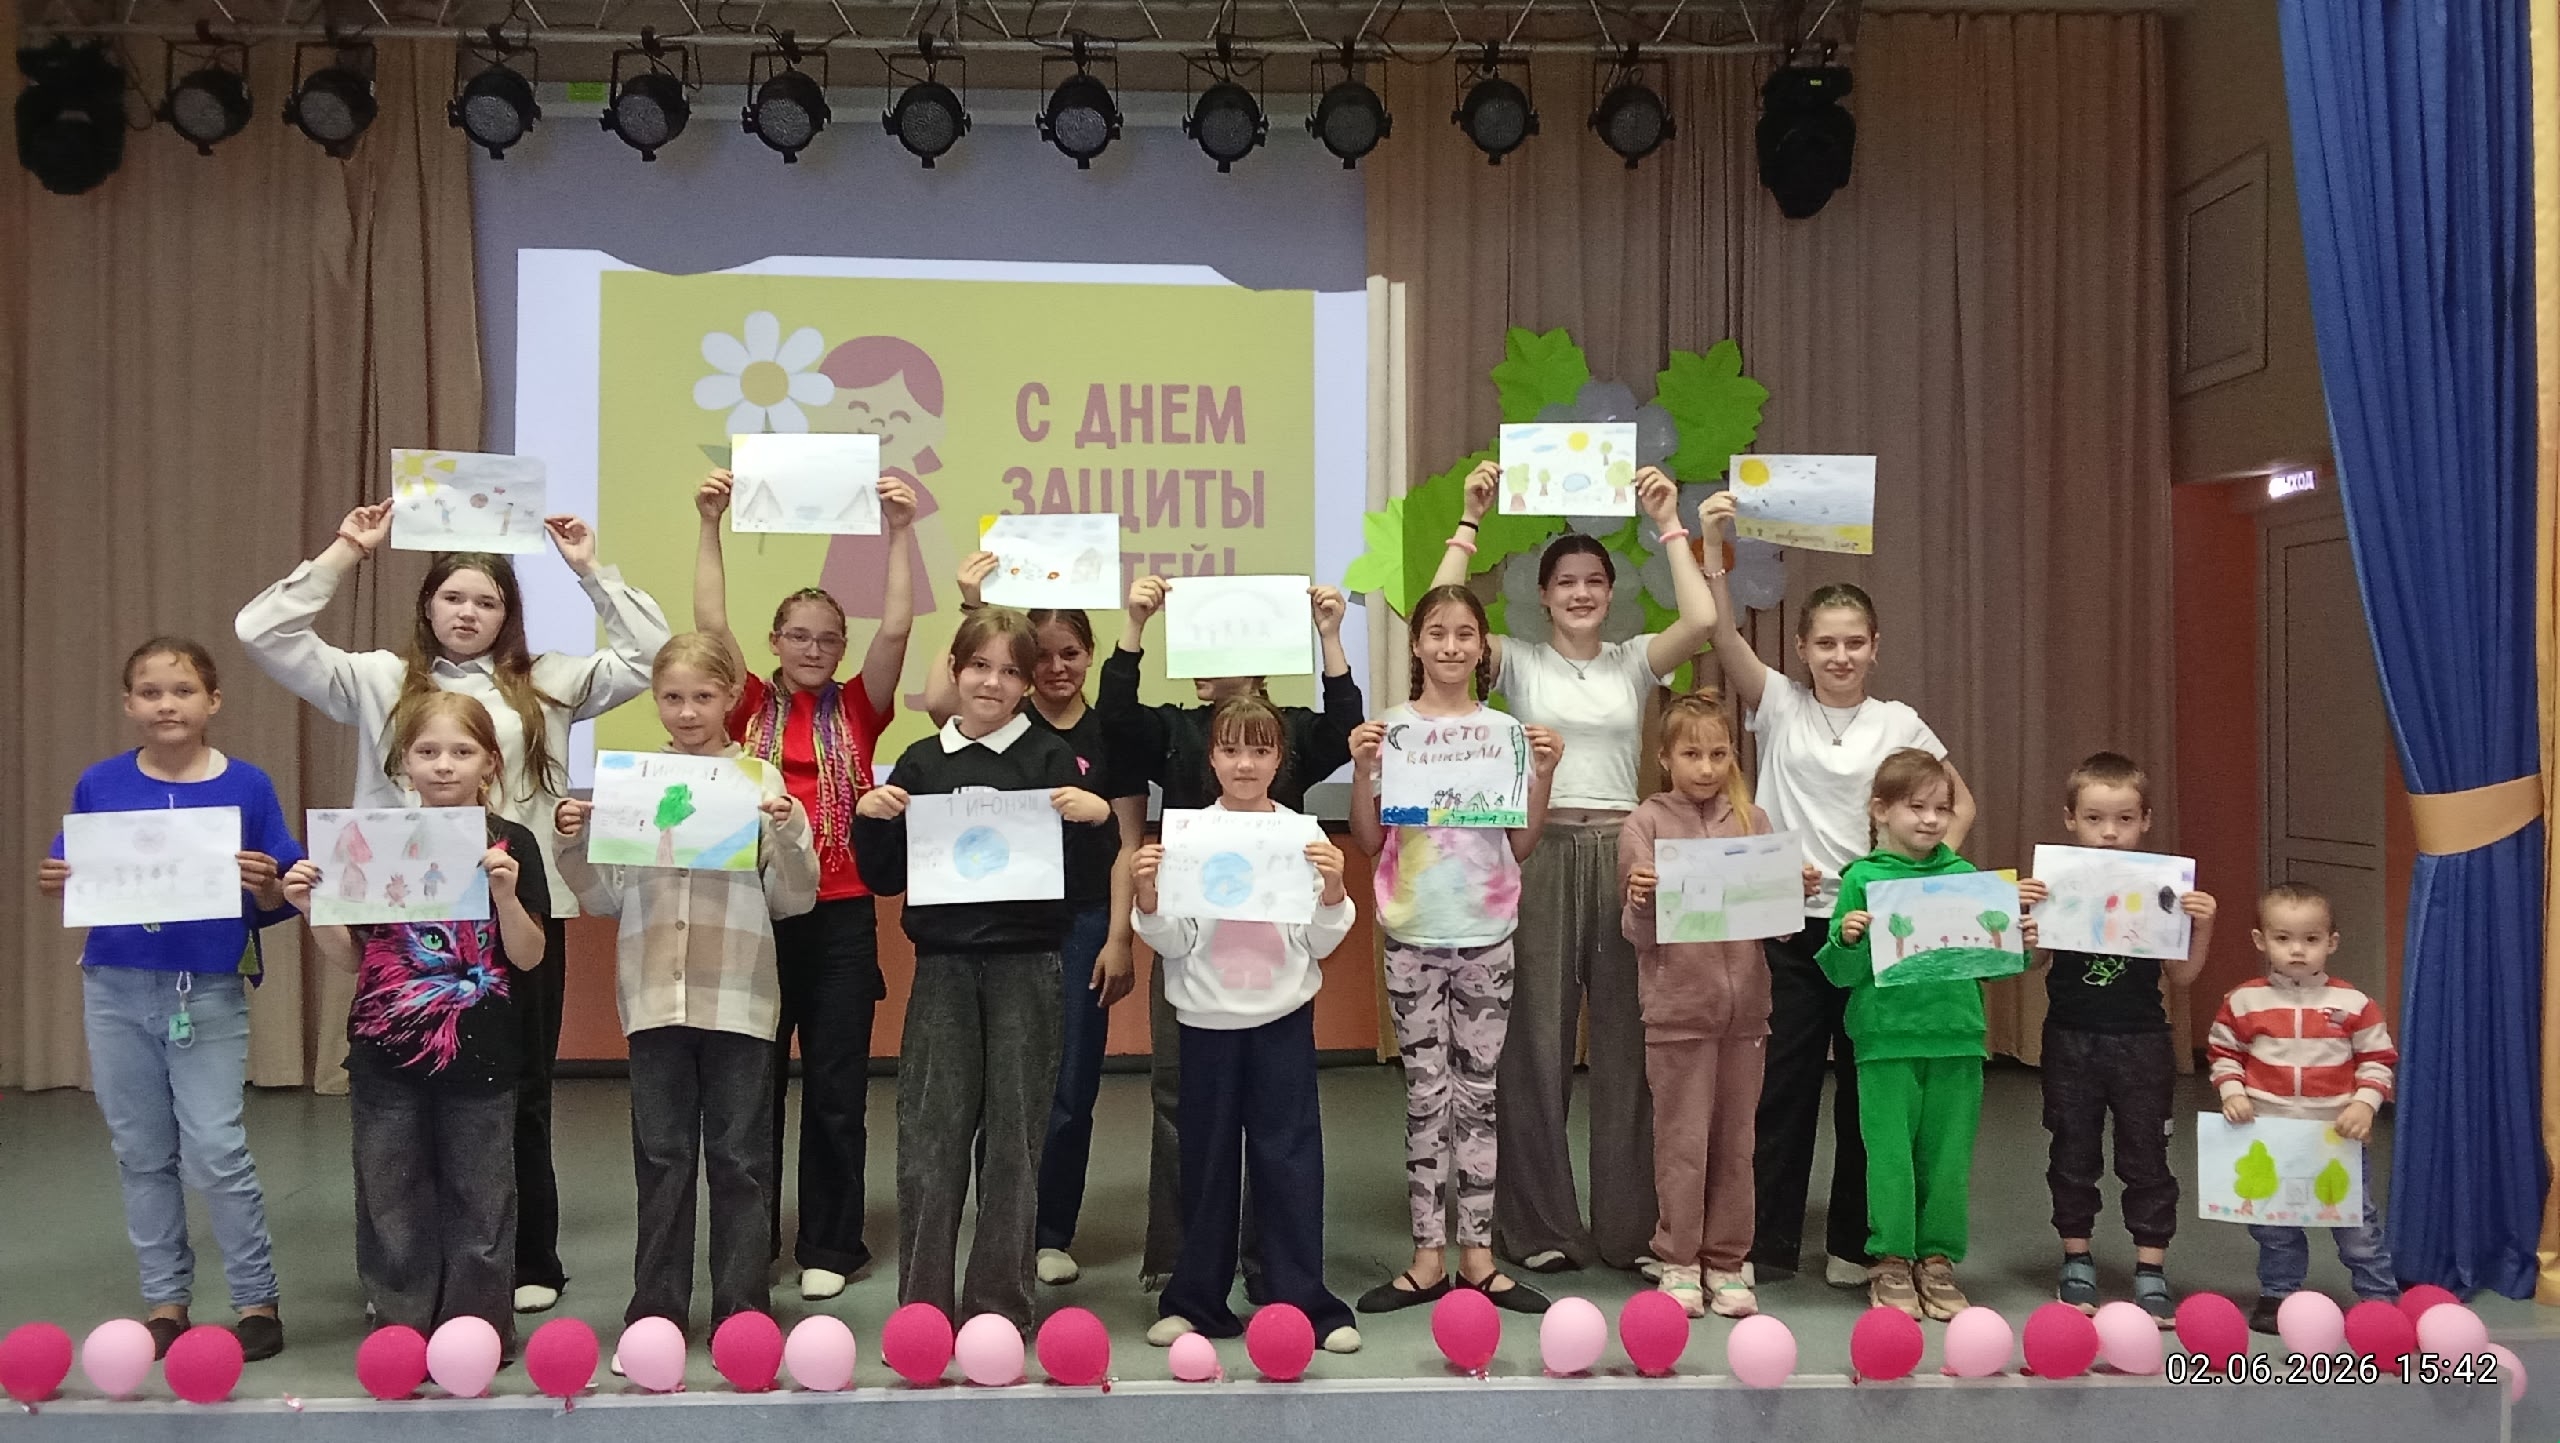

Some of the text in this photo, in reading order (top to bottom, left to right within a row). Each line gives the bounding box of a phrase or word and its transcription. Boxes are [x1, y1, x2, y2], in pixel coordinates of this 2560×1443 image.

[1015, 382, 1246, 449] С ДНЕМ
[1000, 467, 1265, 533] ЗАЩИТЫ
[944, 796, 953, 817] 1
